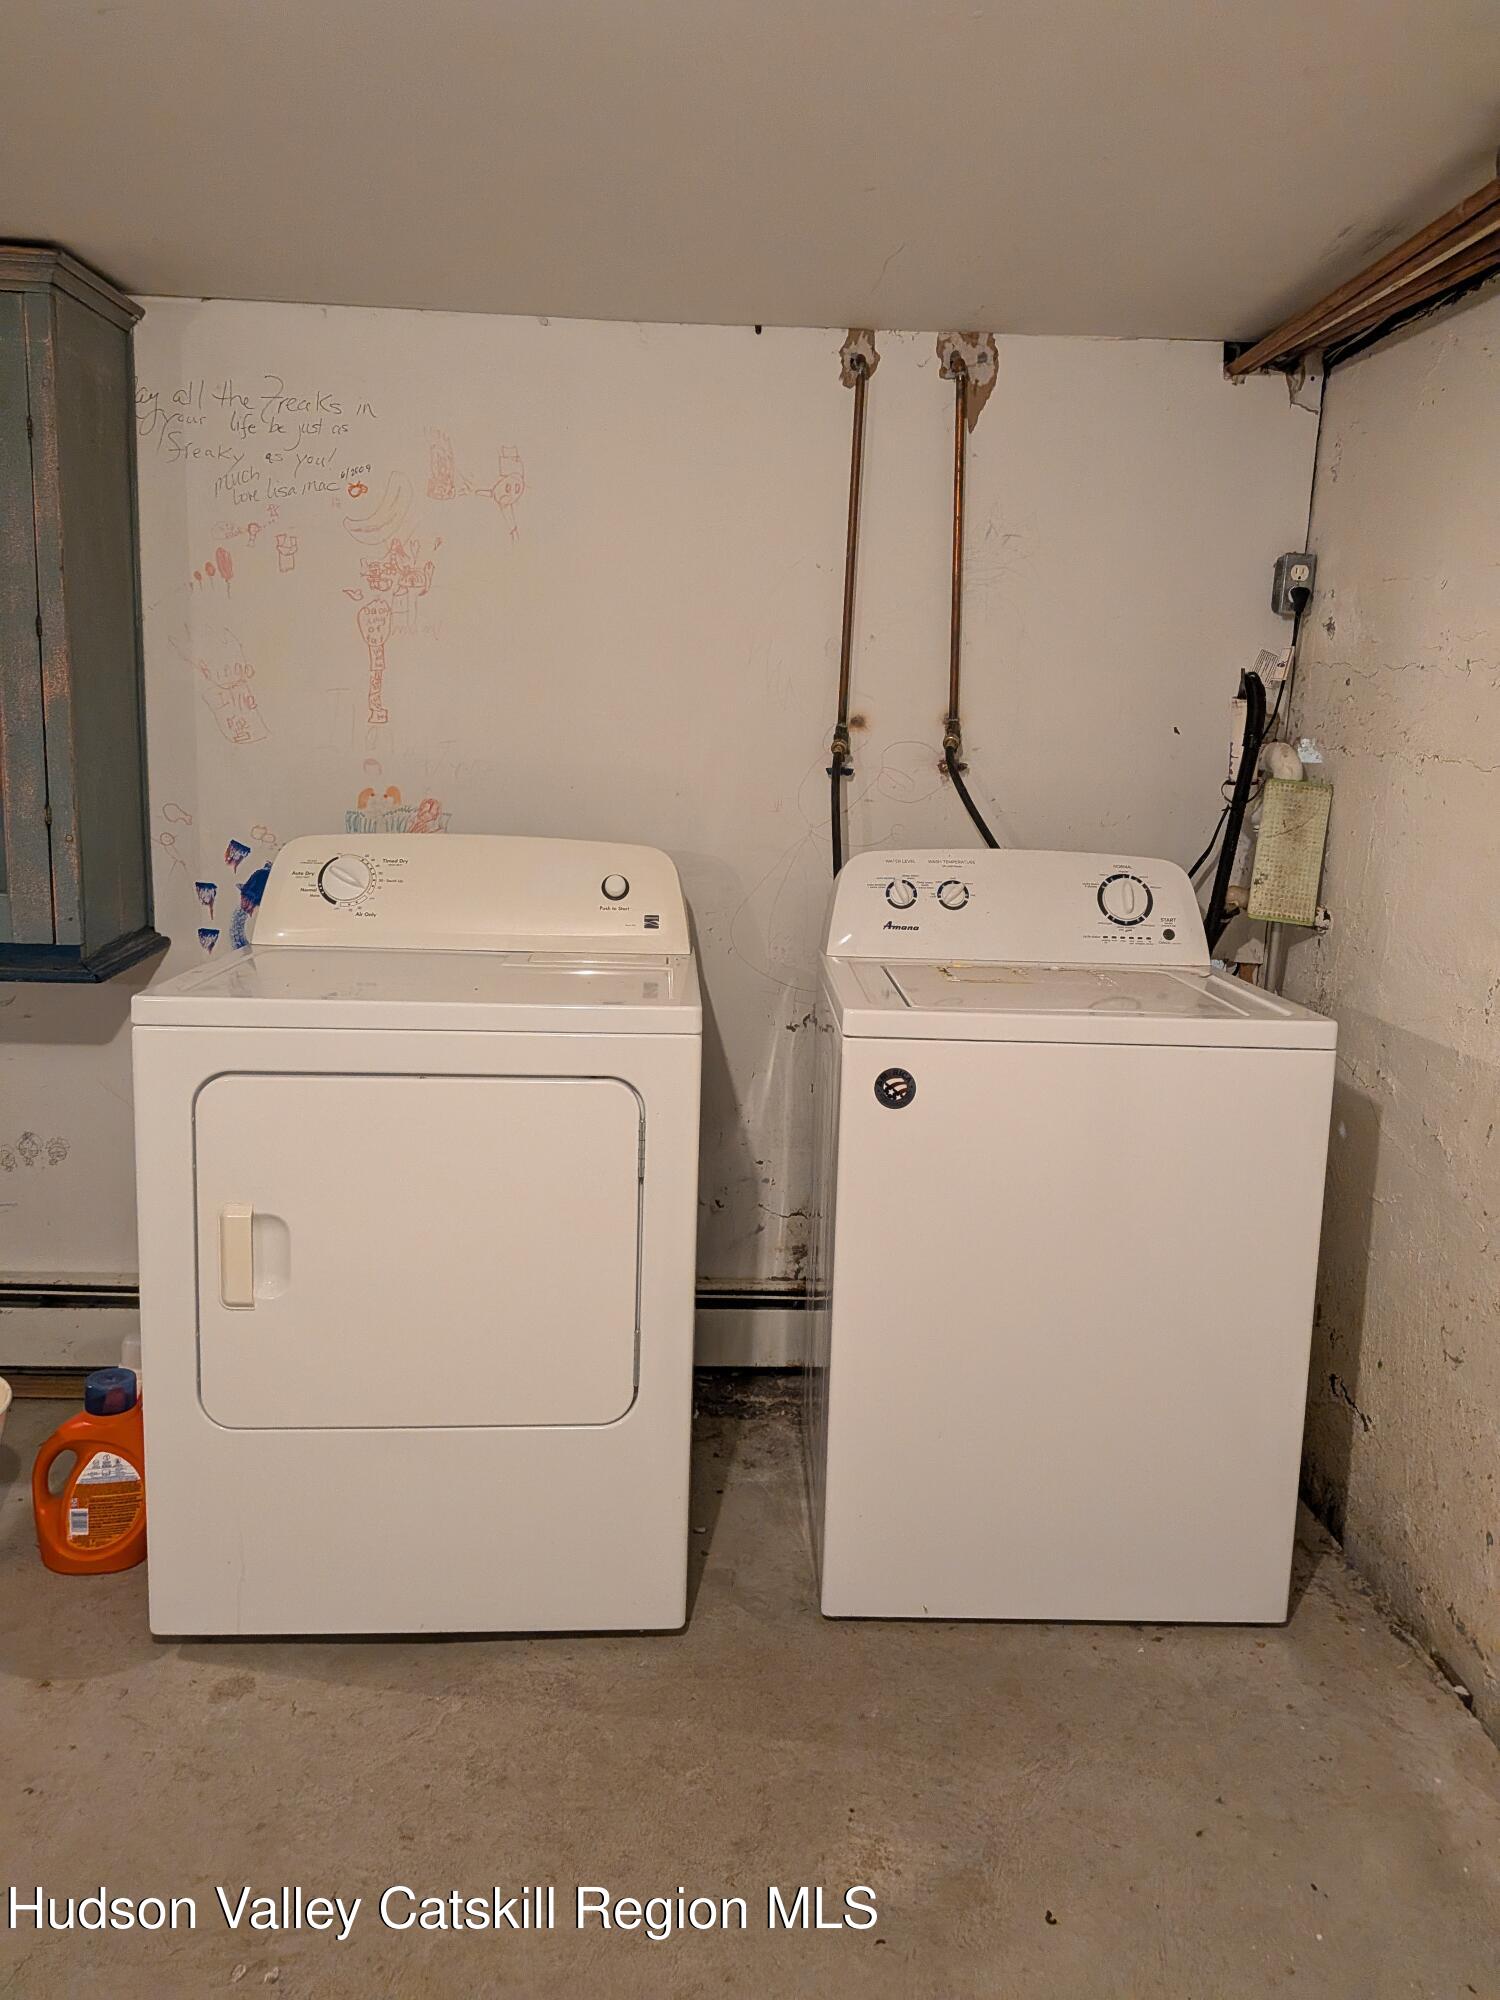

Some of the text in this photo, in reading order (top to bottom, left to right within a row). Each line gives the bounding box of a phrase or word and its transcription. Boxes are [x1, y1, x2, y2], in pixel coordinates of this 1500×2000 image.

[173, 380, 205, 410] all
[211, 379, 256, 410] the
[356, 402, 377, 419] in
[230, 410, 256, 440] life
[269, 416, 287, 433] be
[332, 424, 349, 435] as
[882, 920, 920, 931] Amana
